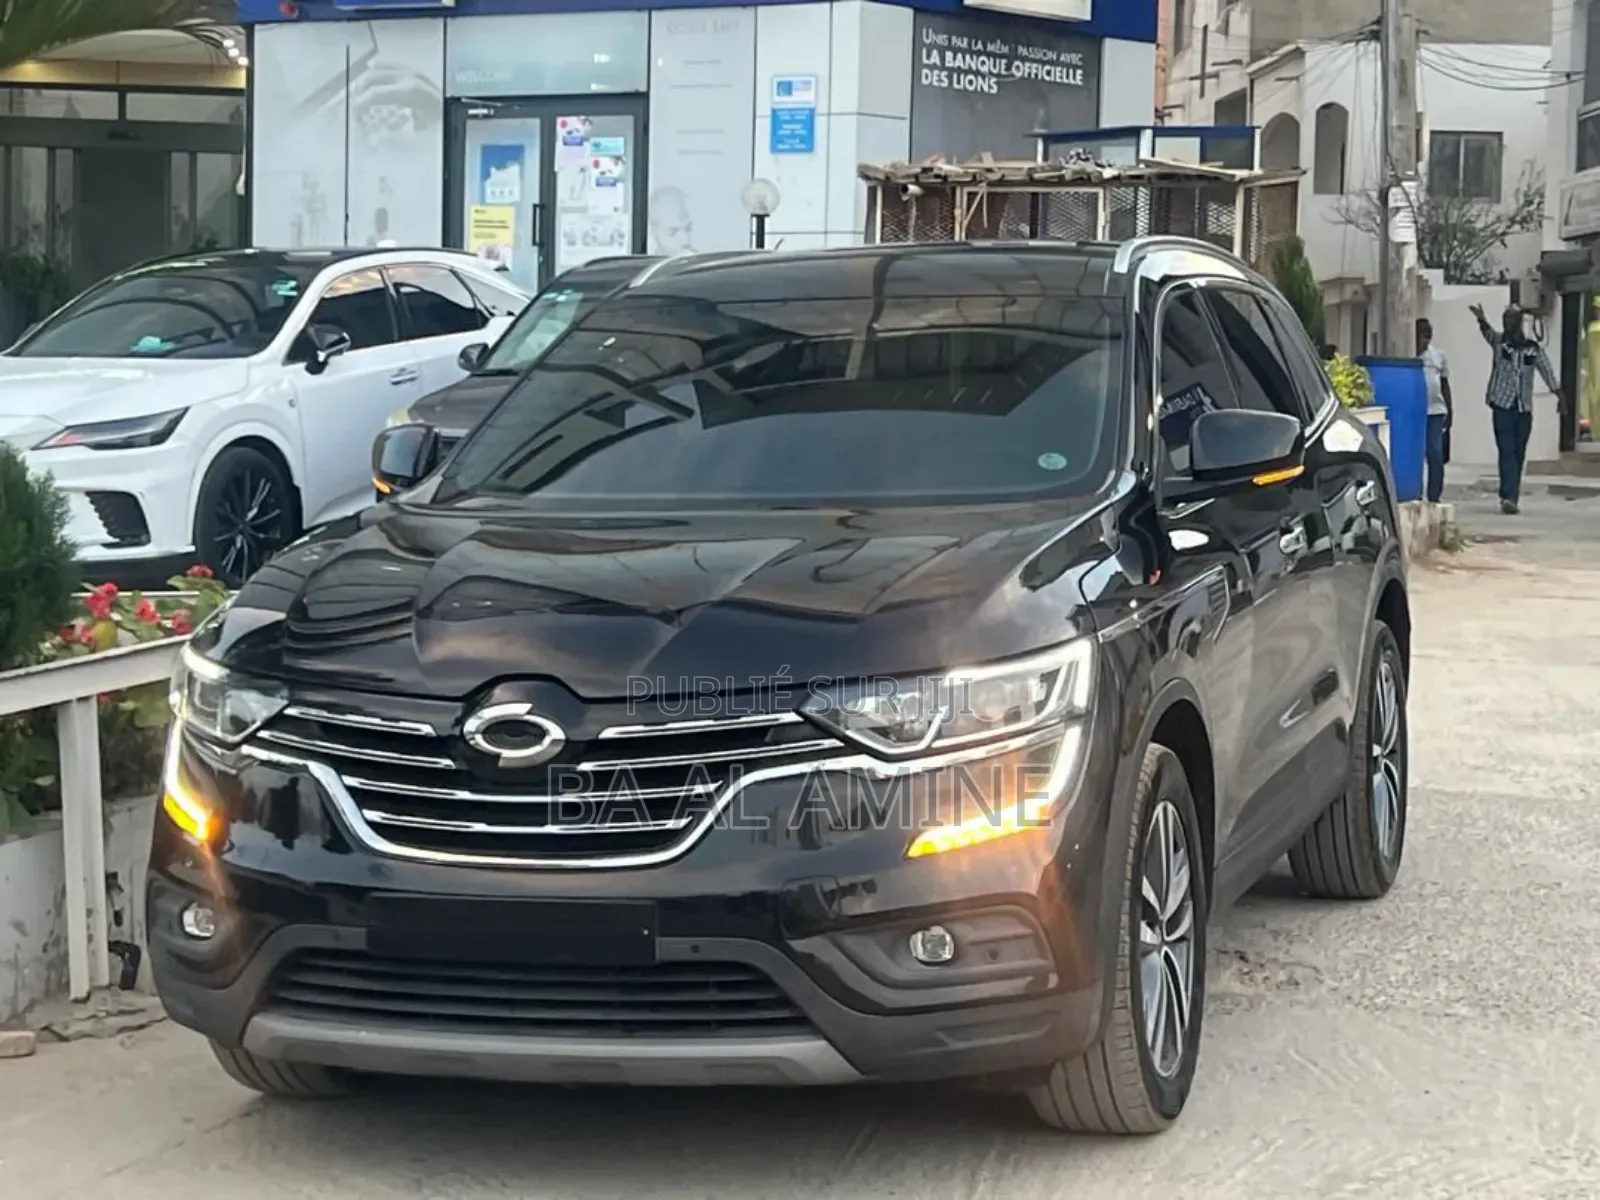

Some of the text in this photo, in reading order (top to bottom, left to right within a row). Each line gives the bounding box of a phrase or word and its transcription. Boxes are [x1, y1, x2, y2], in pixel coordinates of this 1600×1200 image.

[922, 47, 1084, 87] LA BANQUE OFFICIELLE
[951, 35, 969, 50] PAR
[971, 38, 985, 52] LA
[986, 38, 1015, 56] MÊM
[1017, 45, 1058, 61] PASSION
[1060, 52, 1084, 67] AVEC
[921, 68, 998, 94] DES LIONS
